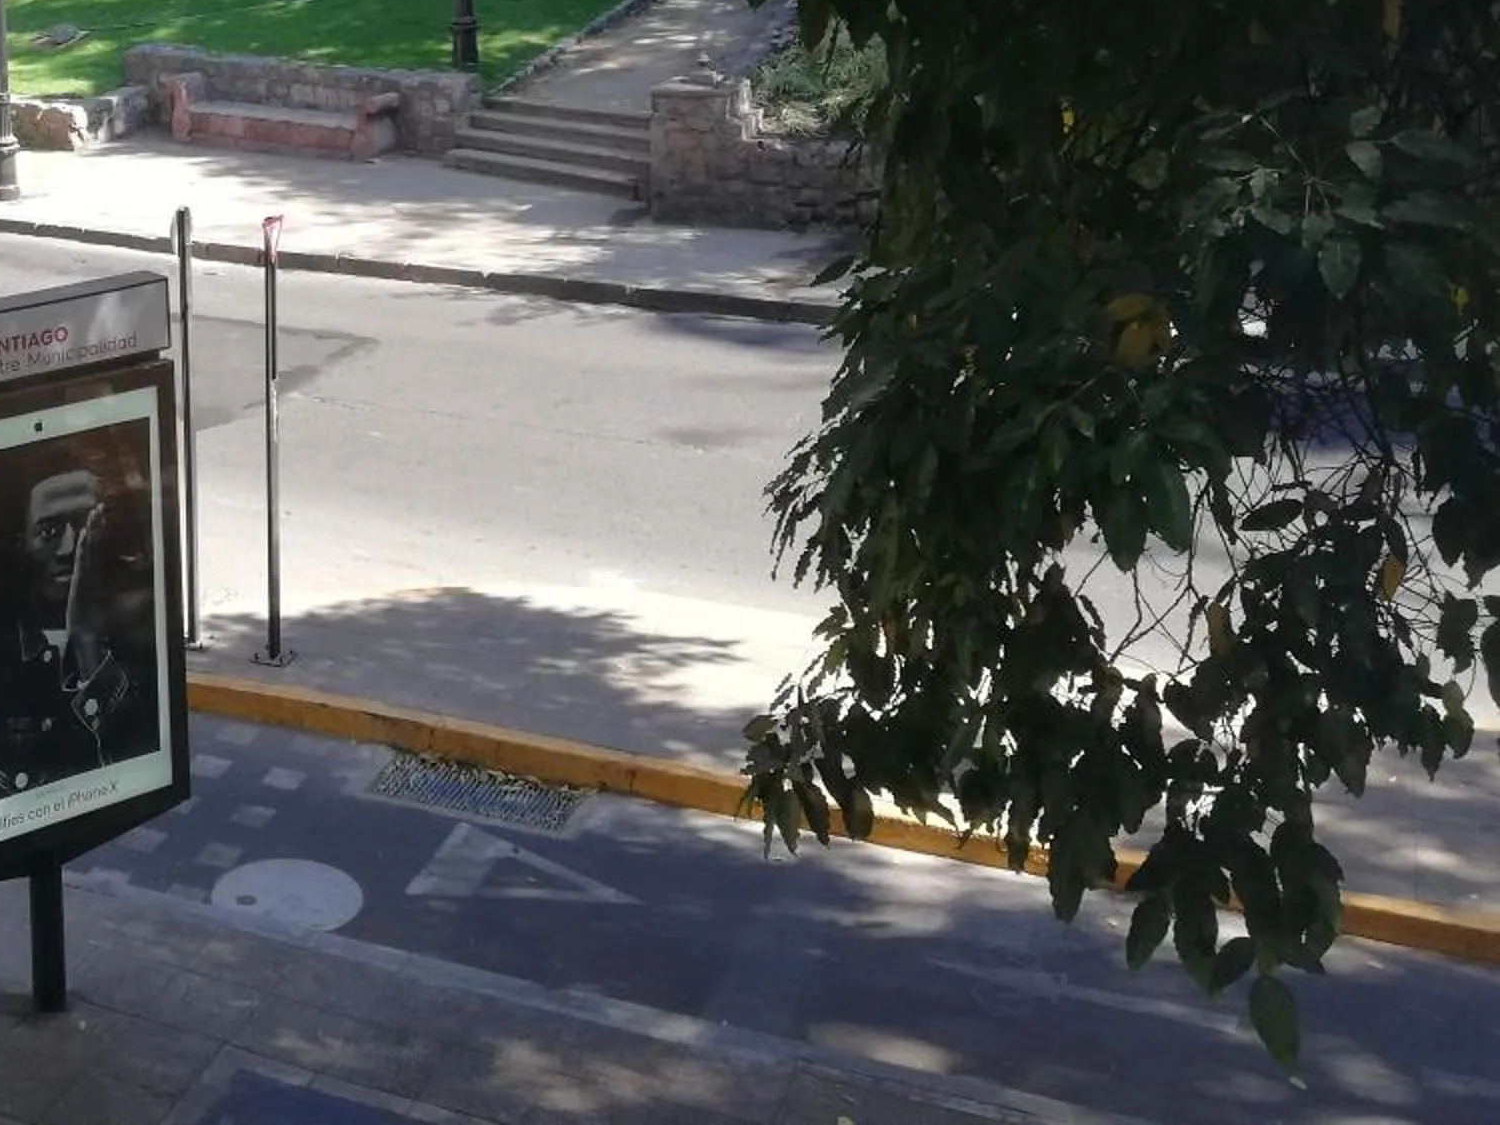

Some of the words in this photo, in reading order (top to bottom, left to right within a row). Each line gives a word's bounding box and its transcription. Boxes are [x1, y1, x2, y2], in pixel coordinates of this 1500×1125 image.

[27, 331, 138, 365] Municipalidad
[26, 801, 49, 819] con
[53, 797, 66, 812] el
[67, 787, 107, 809] iPhone
